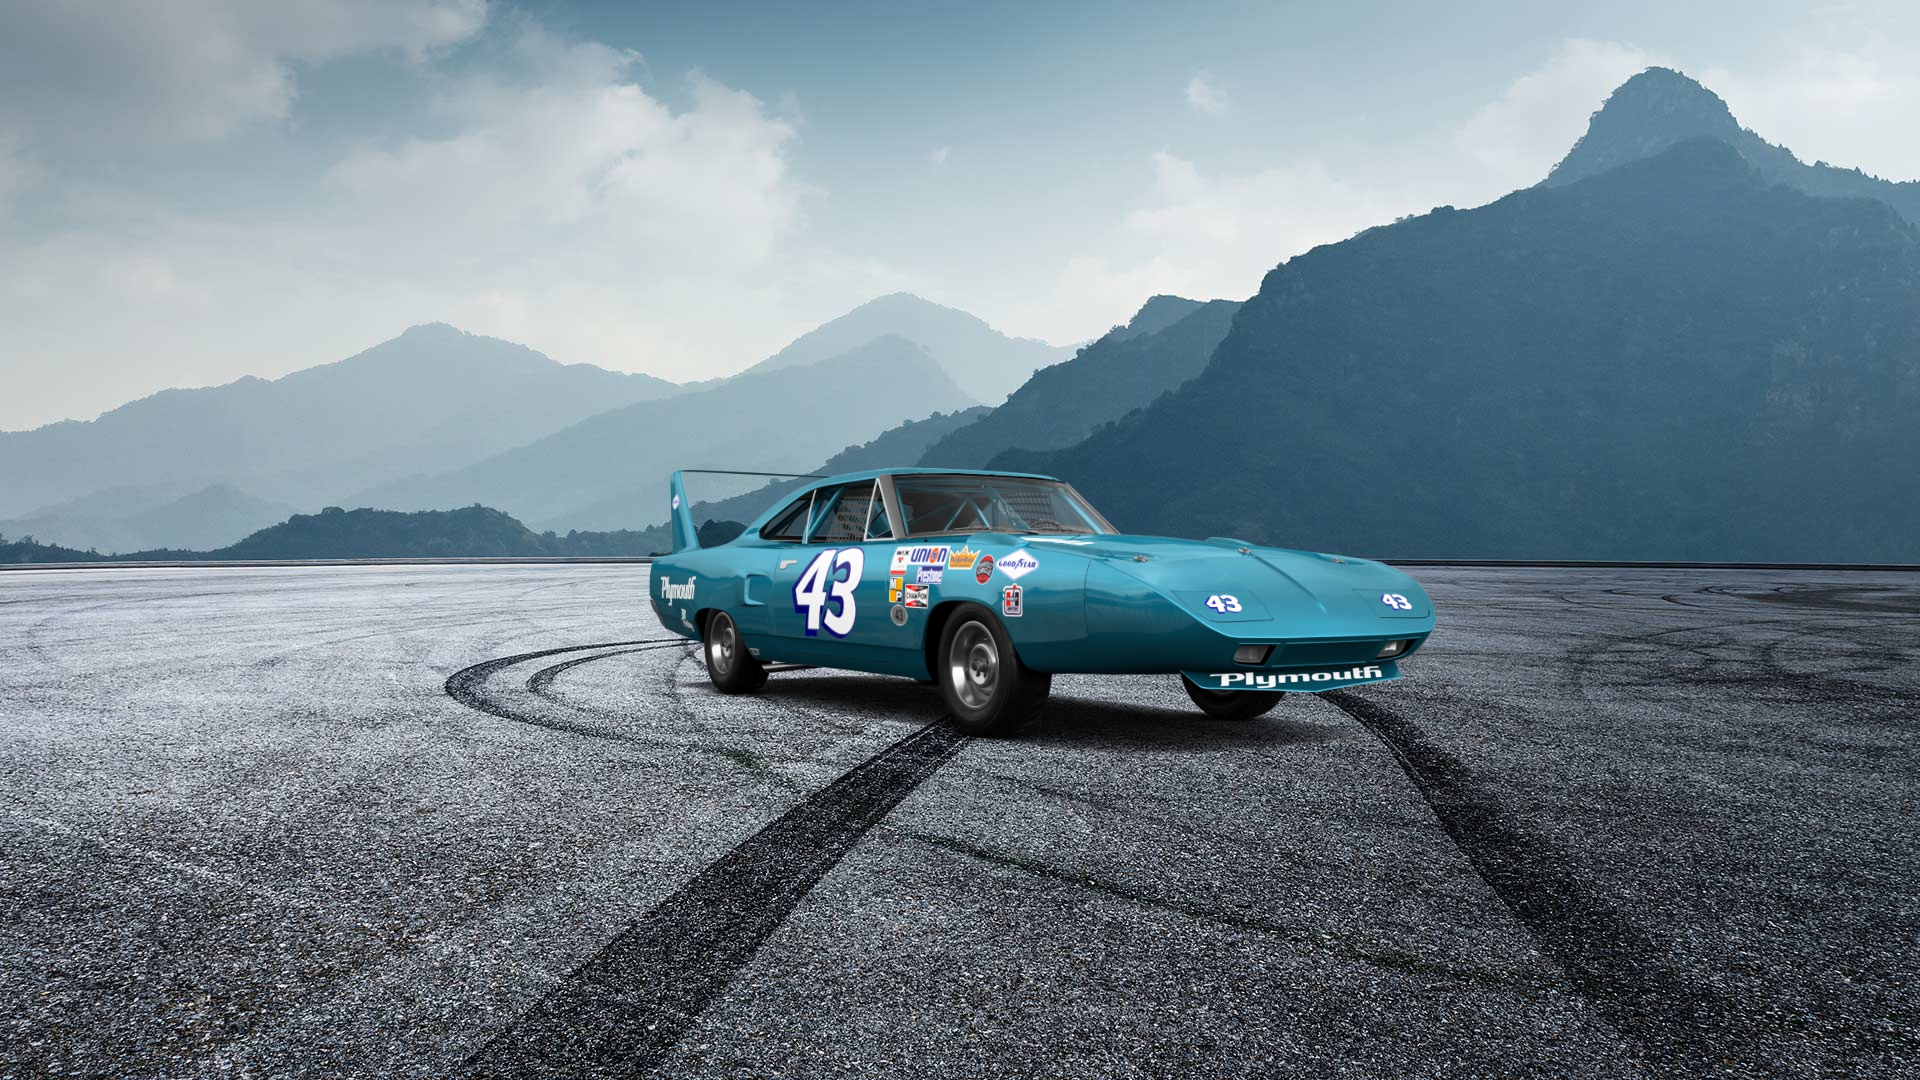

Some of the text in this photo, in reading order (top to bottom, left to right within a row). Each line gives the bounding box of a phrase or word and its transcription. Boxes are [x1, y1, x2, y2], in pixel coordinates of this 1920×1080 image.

[910, 547, 948, 563] UNION
[660, 575, 697, 607] Plymouth
[791, 547, 865, 639] 43
[1204, 594, 1243, 615] 43
[1380, 593, 1413, 611] 43
[894, 609, 904, 622] 43
[1210, 665, 1382, 689] Plymouth
